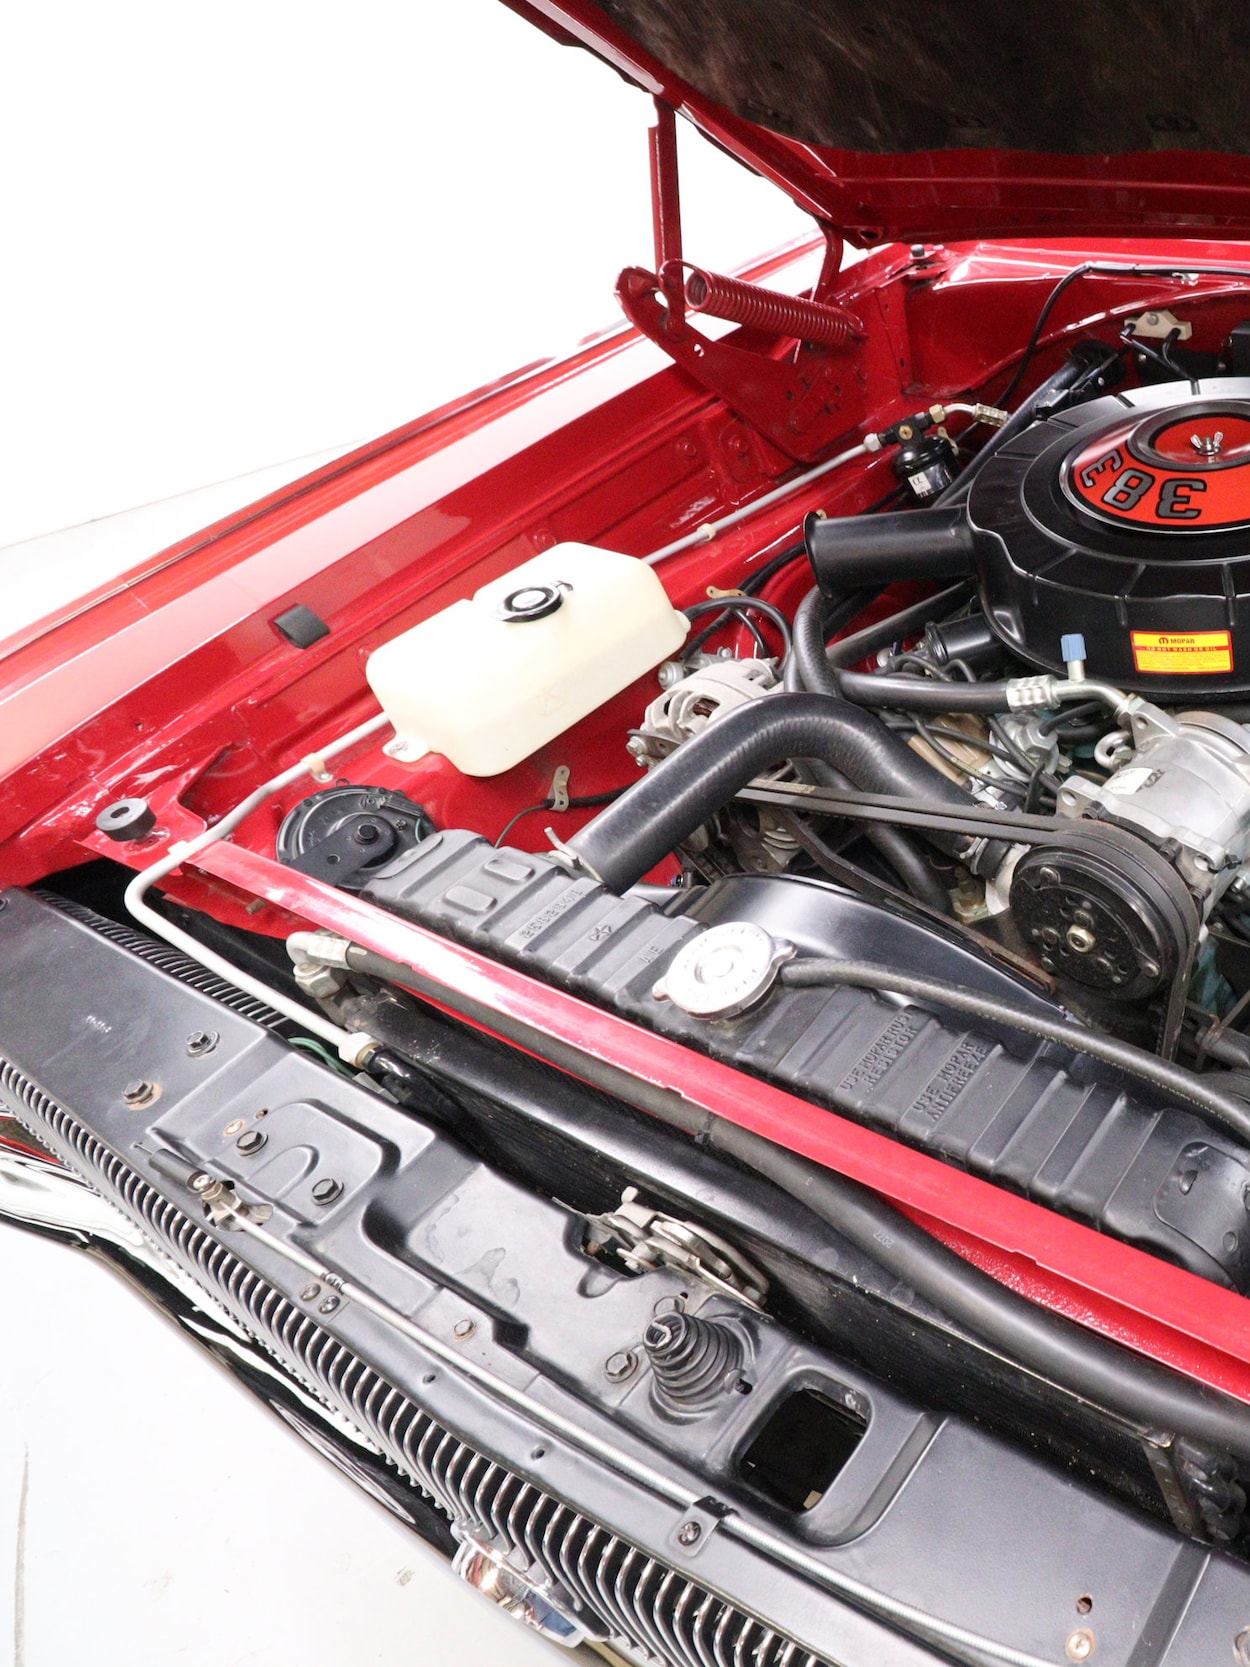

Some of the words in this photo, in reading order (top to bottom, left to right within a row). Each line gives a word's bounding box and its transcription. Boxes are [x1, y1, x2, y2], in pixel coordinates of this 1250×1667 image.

[1079, 447, 1208, 520] 383
[1170, 637, 1195, 645] MOPAR
[839, 1066, 866, 1091] USE
[858, 1035, 892, 1071] MOPAR
[912, 1085, 940, 1112] USE
[936, 1041, 975, 1082] MOPAR
[925, 1045, 988, 1122] ANTIFREEZE
[872, 1230, 895, 1249] 2077
